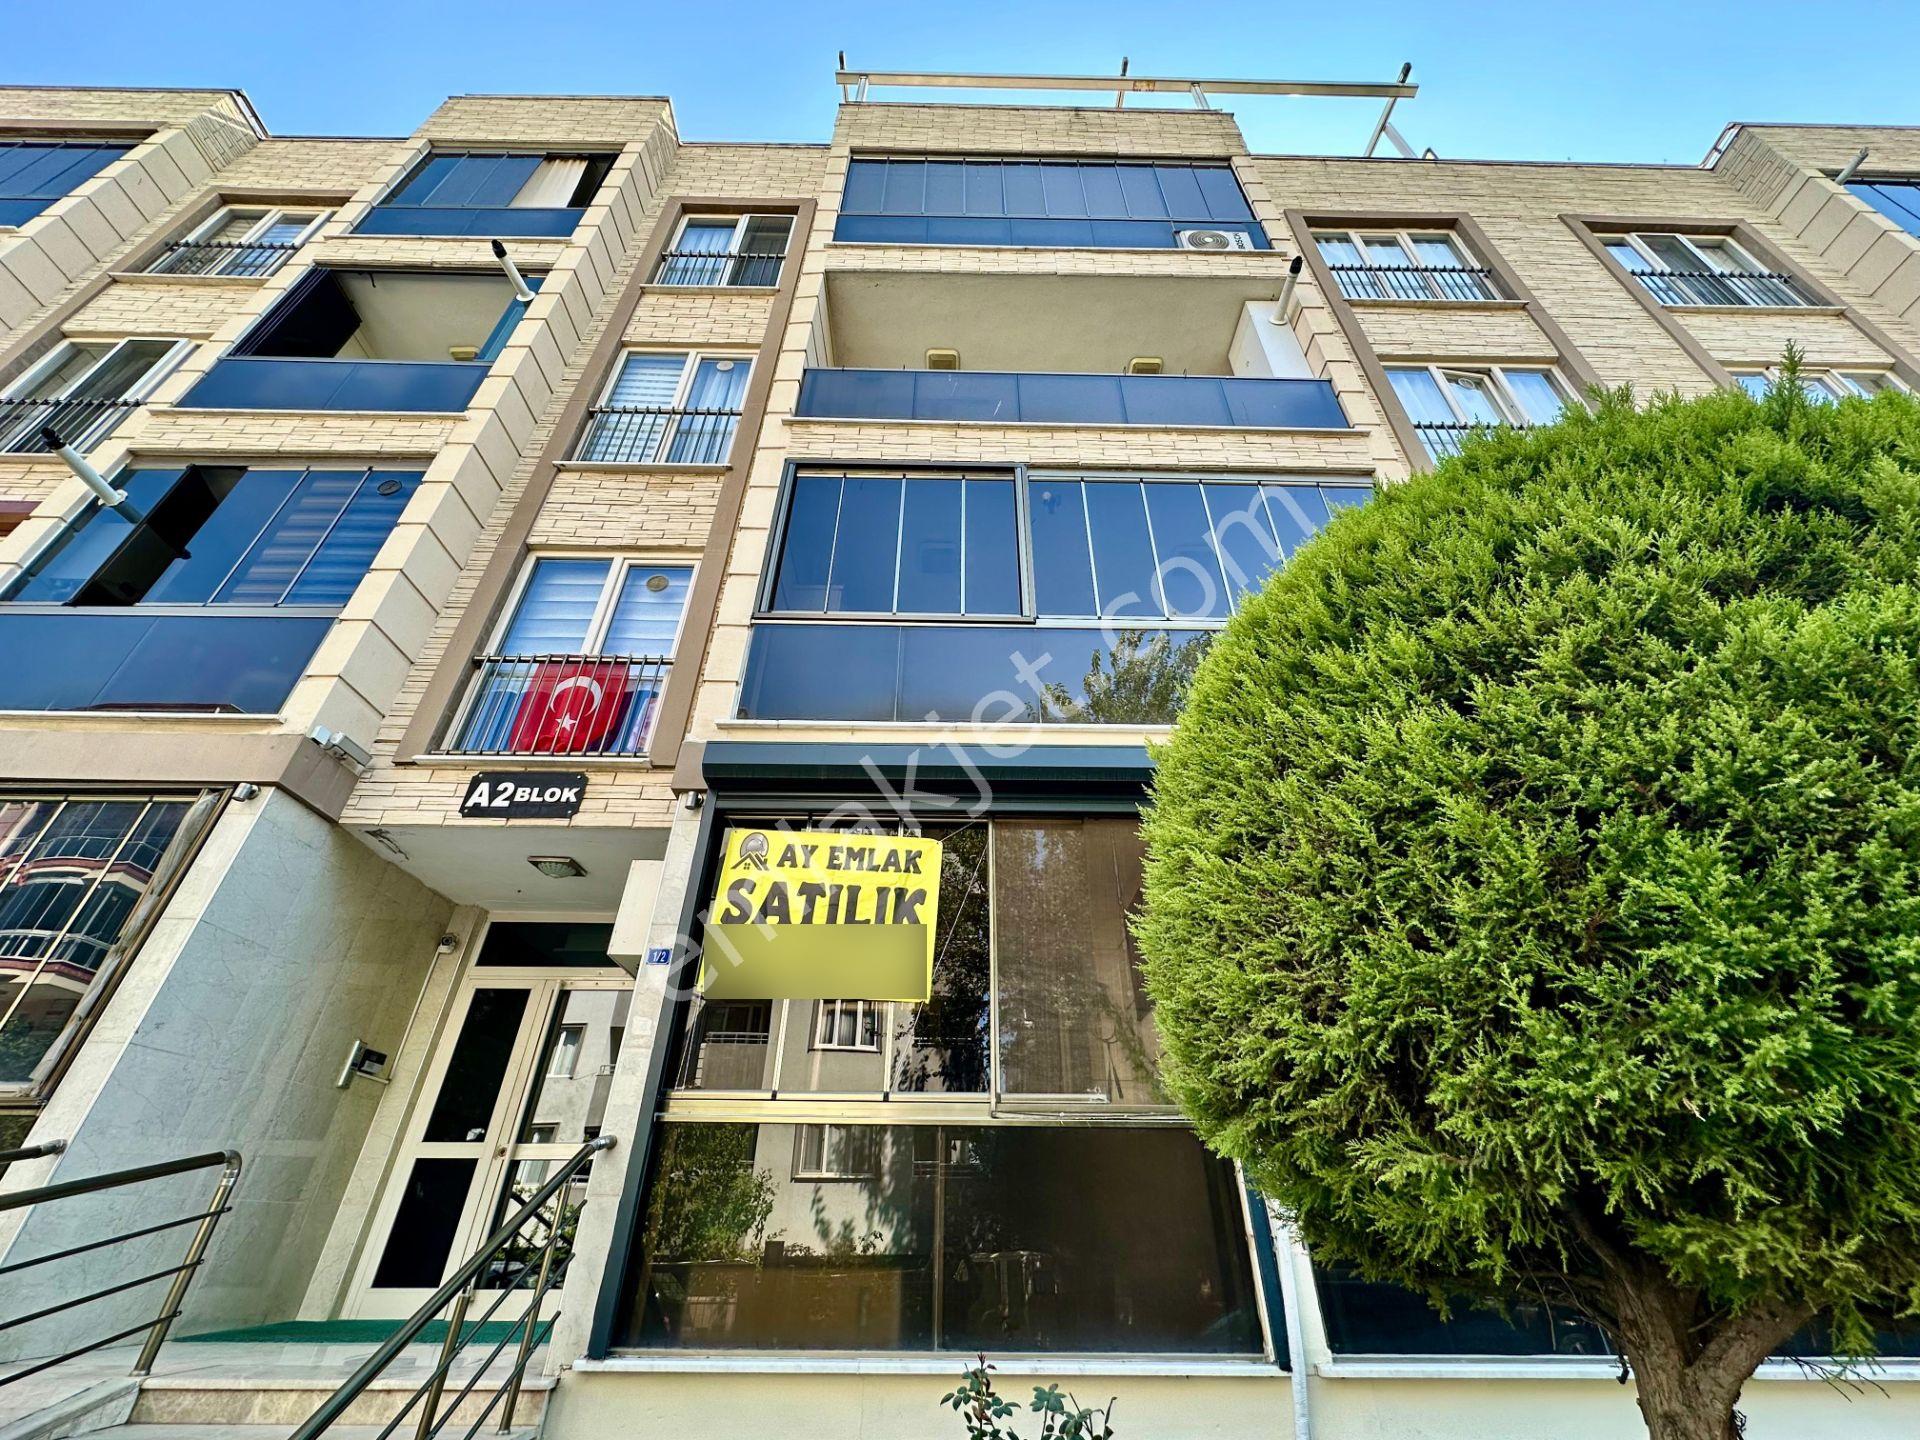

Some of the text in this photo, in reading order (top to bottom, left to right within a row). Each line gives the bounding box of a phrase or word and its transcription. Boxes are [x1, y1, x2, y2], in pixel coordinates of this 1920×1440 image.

[464, 782, 580, 807] A2 BLOK
[776, 843, 922, 874] AY EMLAK
[720, 878, 928, 924] SATILIK
[652, 950, 667, 962] 1/2
